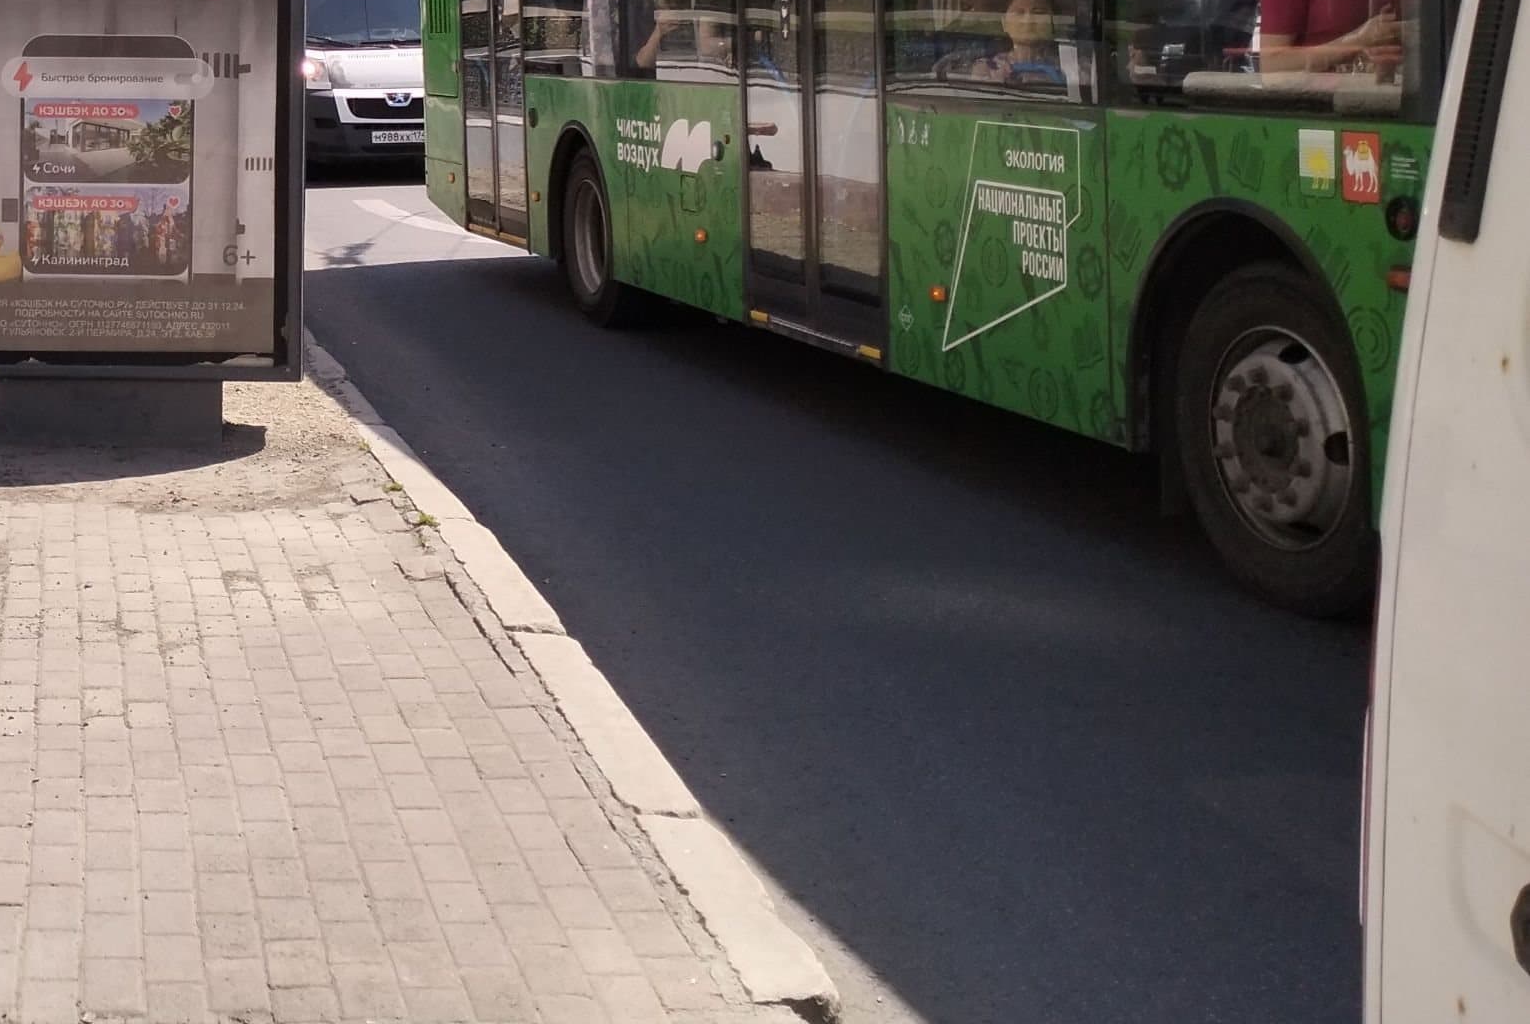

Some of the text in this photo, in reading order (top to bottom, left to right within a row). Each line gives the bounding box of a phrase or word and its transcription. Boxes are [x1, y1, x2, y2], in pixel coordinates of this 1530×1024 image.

[41, 72, 164, 84] Быстрое бронирование
[39, 106, 135, 118] КЭШБЭК ДО 30%
[1005, 149, 1065, 173] ЭКОЛОГИЯ
[43, 162, 76, 175] Сочи
[38, 198, 134, 210] КЭШБЭК ДО 30%
[978, 187, 1062, 225] НАЦИОНАЛЬНЫЕ
[1013, 220, 1063, 253] ПРОЕКТЫ
[42, 254, 130, 268] Калининград
[223, 245, 256, 267] 6+
[1022, 250, 1063, 282] РОССИИ
[55, 299, 68, 309] НА
[135, 299, 190, 310] ДЕЙСТВУЕТ
[191, 302, 206, 311] ДО
[14, 308, 85, 317] ПОДРОБНОСТИ
[87, 309, 101, 317] НА
[102, 308, 134, 319] САЙТЕ
